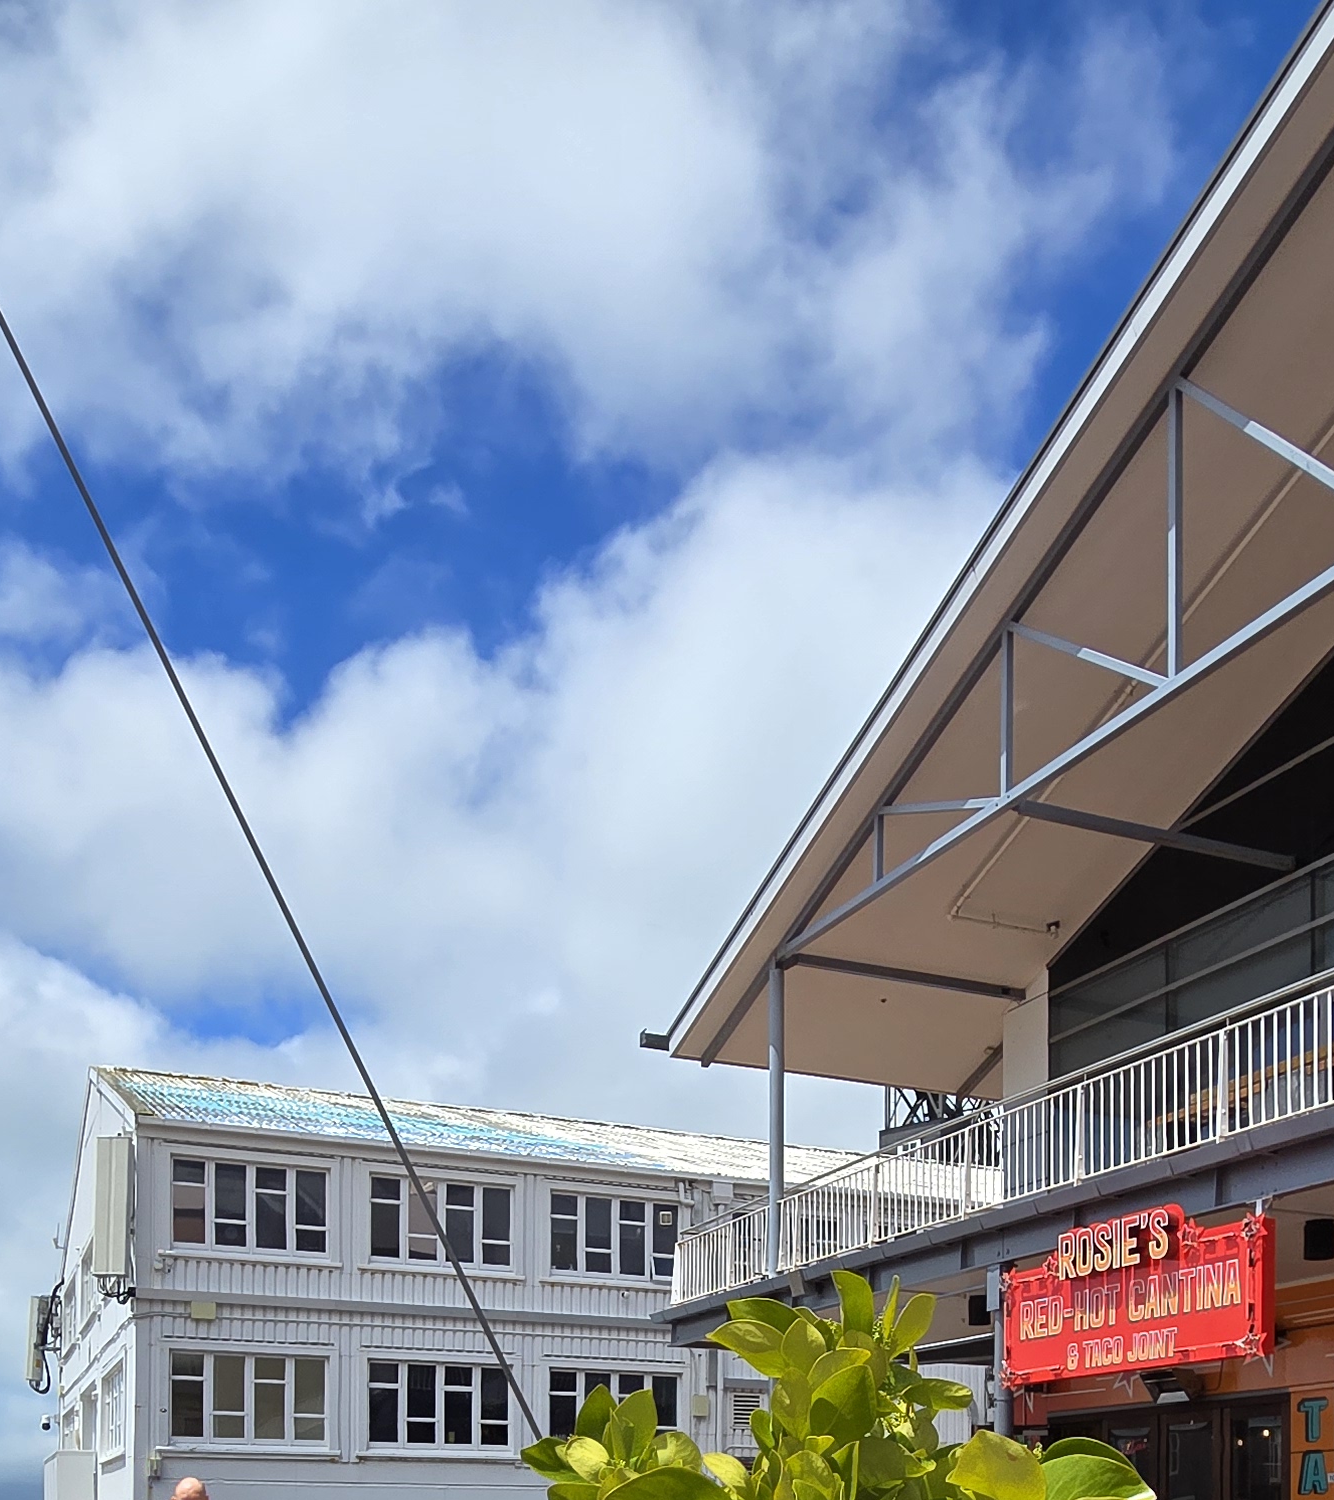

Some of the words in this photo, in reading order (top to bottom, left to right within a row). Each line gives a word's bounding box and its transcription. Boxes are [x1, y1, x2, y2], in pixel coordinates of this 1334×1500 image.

[1058, 1209, 1169, 1280] ROSIE'S
[1020, 1282, 1121, 1340] RED-HOT
[1128, 1258, 1241, 1322] CANTINA
[1067, 1343, 1079, 1370] &
[1082, 1336, 1124, 1368] TACO
[1127, 1328, 1177, 1361] JOINT
